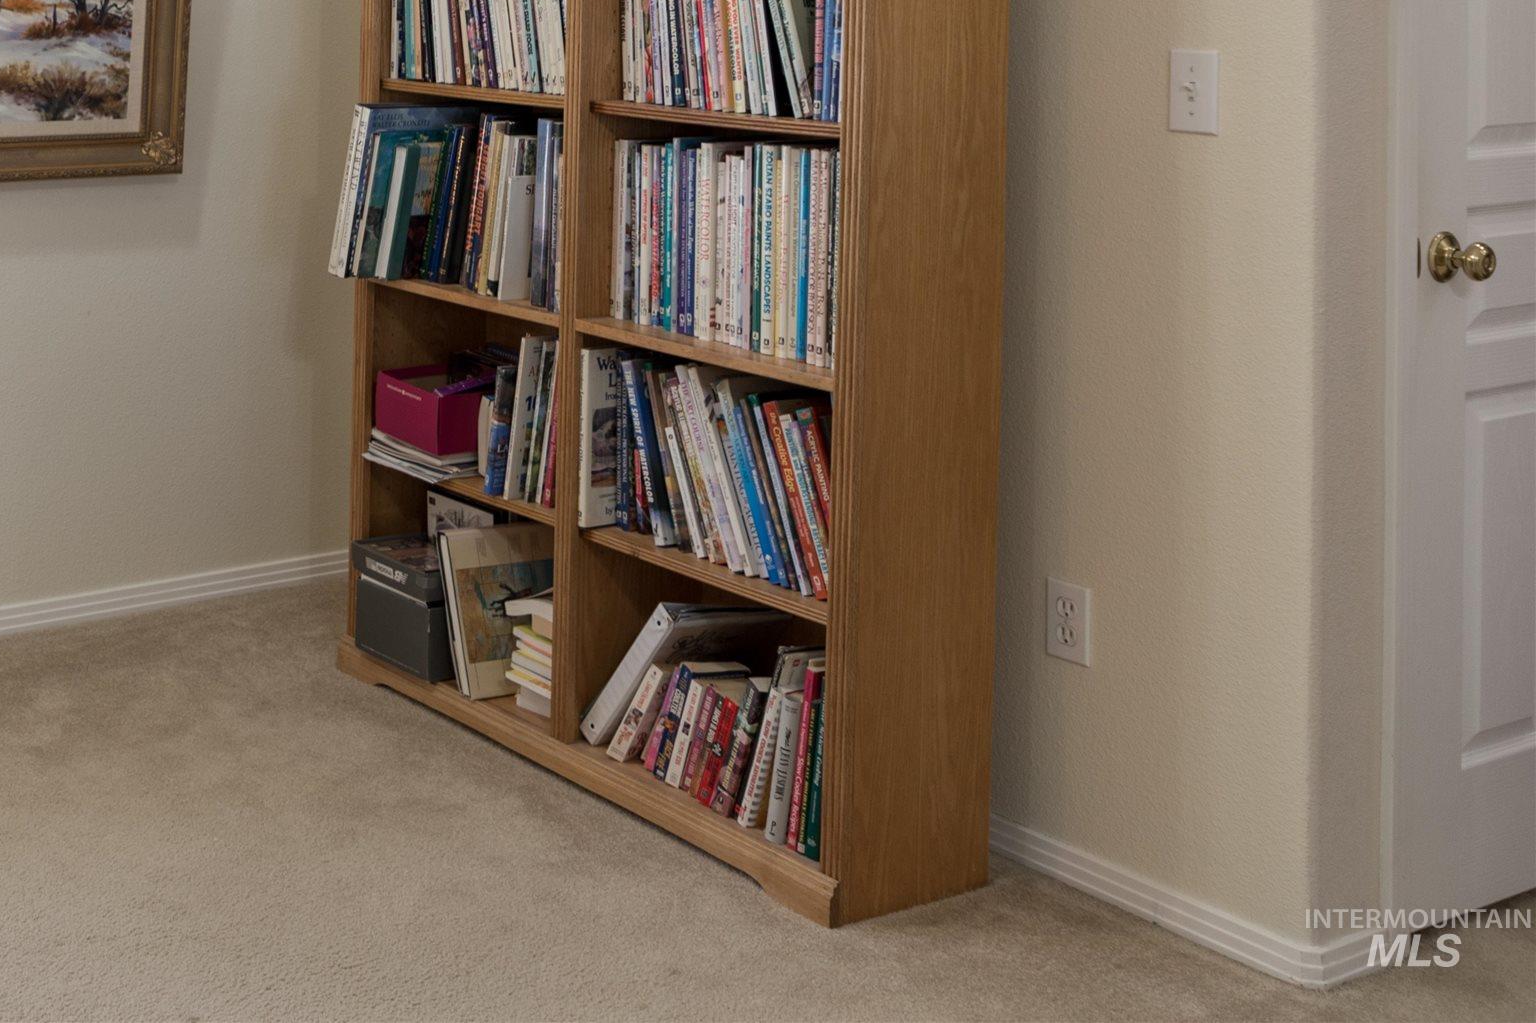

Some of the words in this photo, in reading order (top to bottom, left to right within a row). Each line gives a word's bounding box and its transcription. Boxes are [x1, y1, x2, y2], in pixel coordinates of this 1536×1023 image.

[523, 10, 531, 32] SHARP
[669, 11, 676, 20] IN
[525, 33, 533, 55] FOCUS
[669, 20, 679, 75] WATERCOLOR
[732, 25, 740, 45] EVER
[727, 29, 736, 81] WATERCOLOR
[734, 48, 742, 81] WANTED
[349, 120, 366, 191] WESTWIND
[477, 142, 489, 181] SERGEI
[765, 150, 773, 184] ZOLTAN
[810, 159, 818, 192] MARIO
[472, 184, 485, 236] BONGART
[764, 187, 773, 217] SZABO
[699, 177, 710, 262] WATERCOLOR
[764, 220, 772, 251] PAINTS
[808, 232, 816, 291] WATERCOLOR
[763, 254, 772, 314] LANDSCAPES
[807, 303, 815, 335] DESIGN
[624, 370, 632, 384] THE
[627, 386, 636, 405] NEW
[630, 407, 641, 433] SPIRIT
[768, 411, 778, 425] the
[635, 435, 643, 447] OF
[771, 424, 789, 467] Creative
[638, 448, 653, 503] WATERCOLOR
[781, 466, 797, 494] Edge
[805, 429, 819, 463] ACRYLIC
[814, 462, 830, 502] PAINTING
[726, 443, 745, 494] PAINTING
[743, 505, 763, 558] ACRYLICS
[783, 427, 797, 457] PAINTING
[795, 471, 816, 526] UNDERSTANDING
[810, 526, 826, 562] ABSTRACT
[820, 561, 830, 575] ART
[669, 688, 682, 714] COULTER
[761, 718, 772, 738] SLOW
[795, 756, 804, 776] Slow
[792, 775, 802, 804] Cooker
[788, 804, 799, 832] Recipes
[798, 812, 806, 843] COOKING
